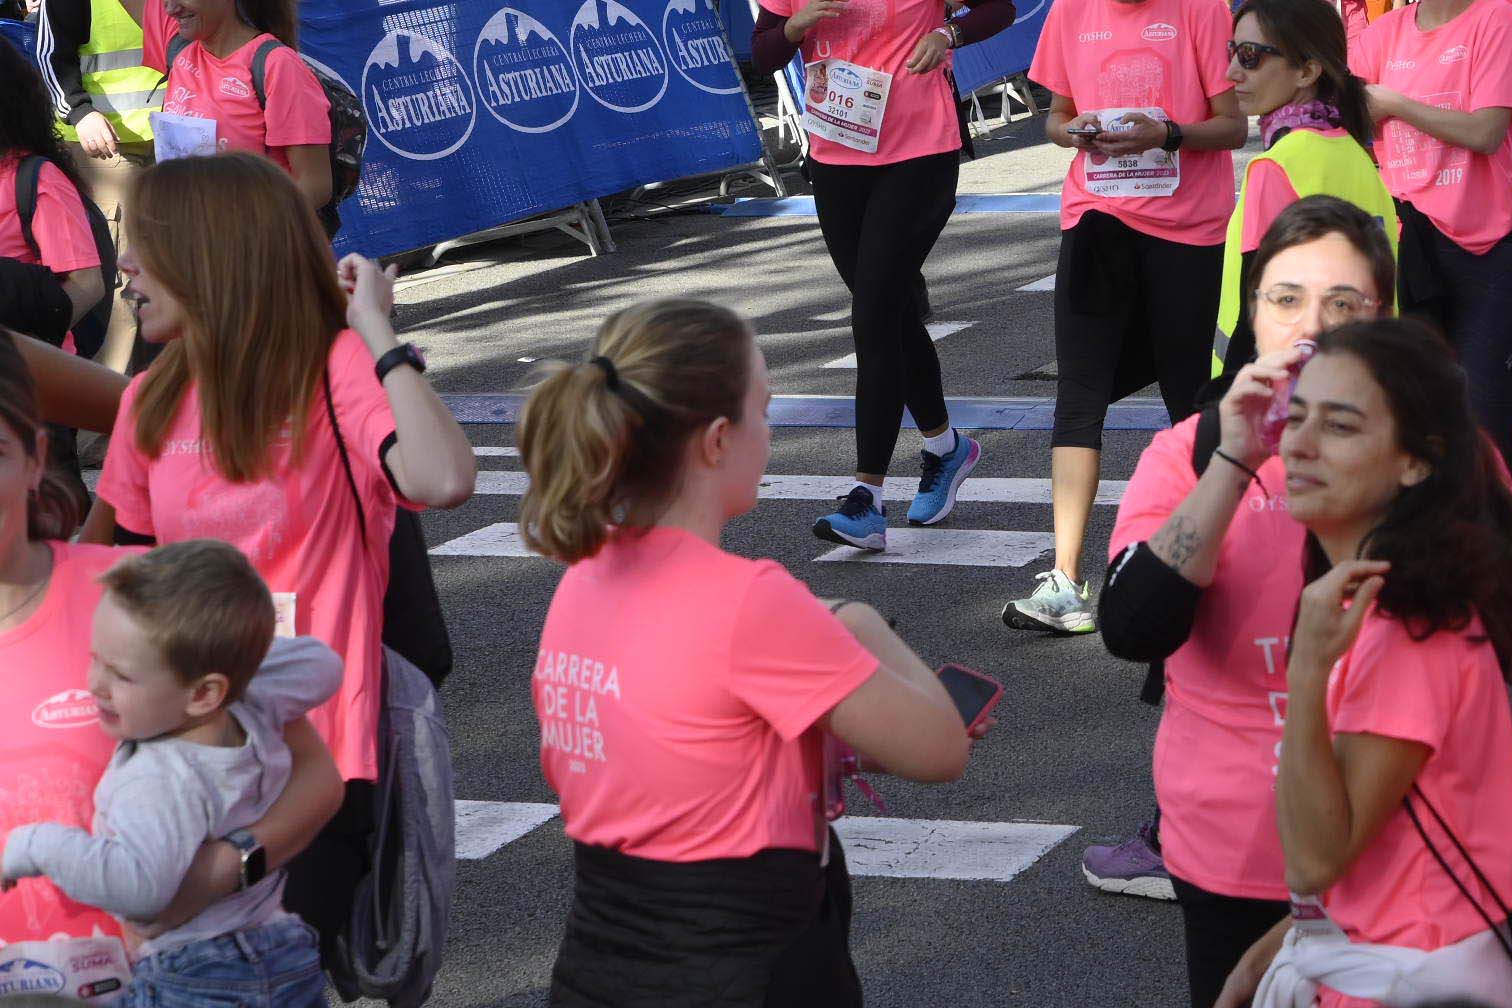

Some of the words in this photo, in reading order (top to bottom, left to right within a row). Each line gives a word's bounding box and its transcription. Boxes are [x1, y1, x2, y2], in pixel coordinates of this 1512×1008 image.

[1079, 30, 1113, 43] OYSHO
[483, 57, 576, 108] ASTURIANA
[579, 42, 664, 88] ASTURIANA
[373, 83, 472, 135] ASTURIANA
[829, 90, 855, 109] 016
[1117, 159, 1138, 168] 5838
[1435, 167, 1463, 186] 2019
[534, 648, 621, 701] CARRERA
[544, 683, 568, 719] DE
[574, 691, 600, 727] LA
[541, 719, 608, 763] MUJER
